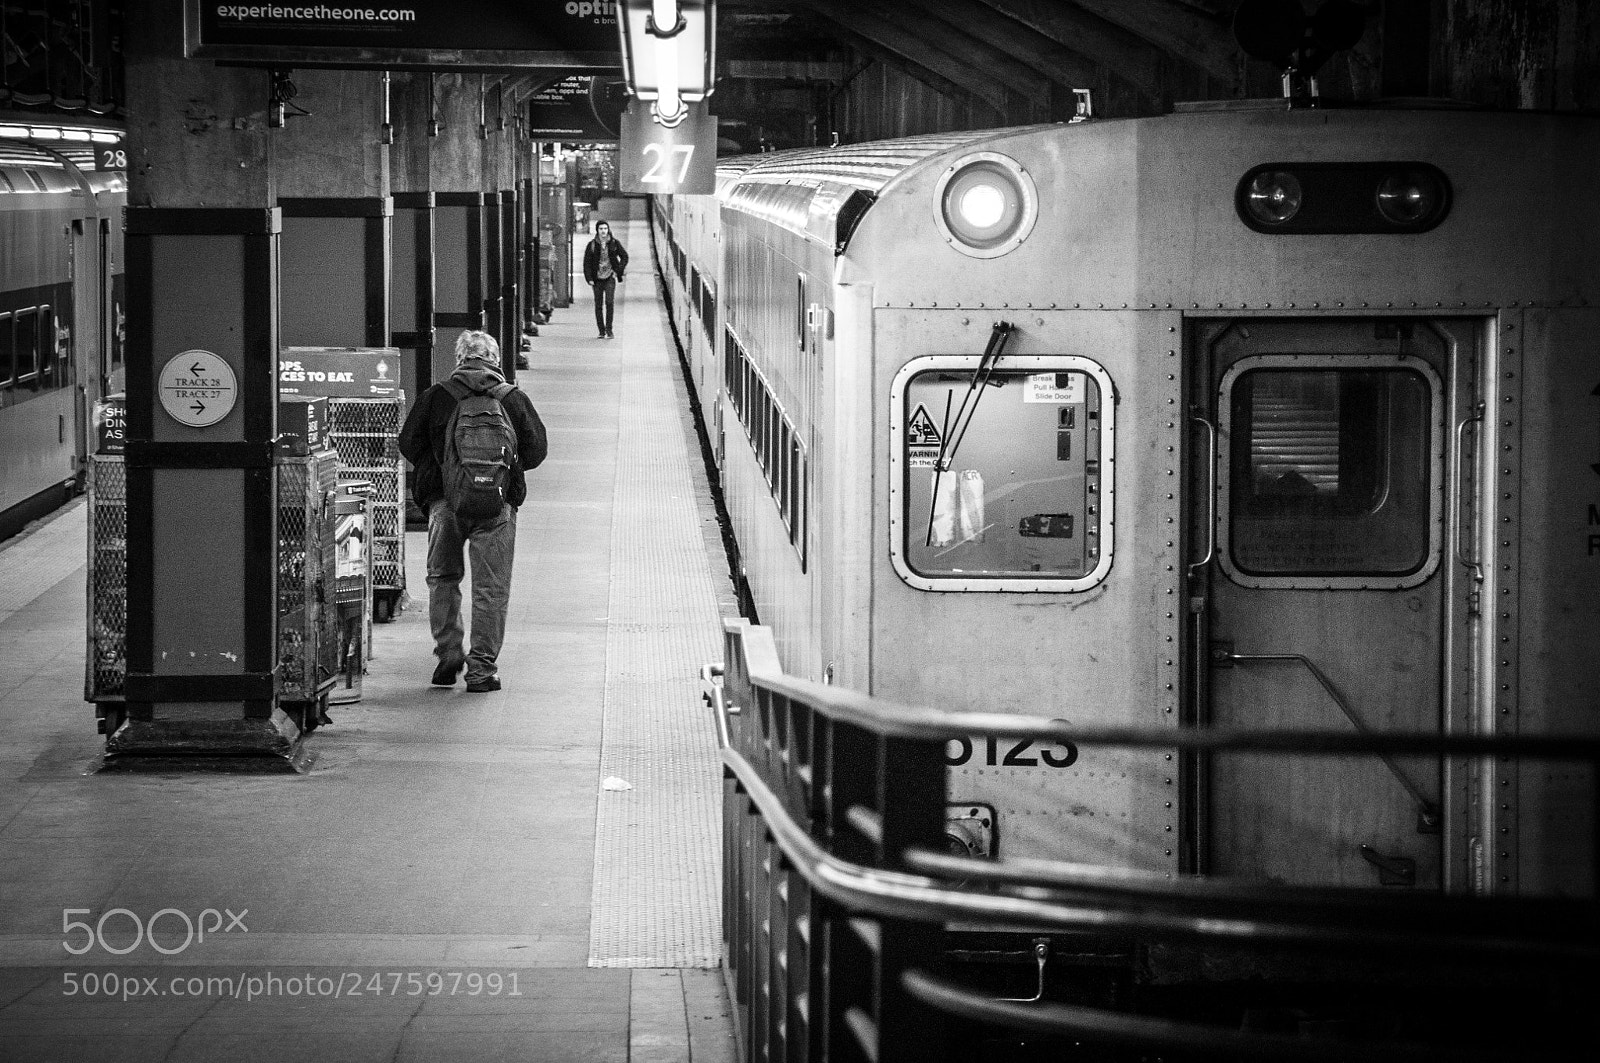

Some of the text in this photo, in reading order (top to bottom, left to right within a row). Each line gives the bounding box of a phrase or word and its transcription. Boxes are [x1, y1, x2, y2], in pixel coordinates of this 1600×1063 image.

[217, 3, 416, 21] experiencetheone.com
[602, 17, 617, 25] bra
[103, 150, 128, 168] 28
[640, 143, 695, 184] 27
[280, 371, 355, 383] CES TO EAT.
[175, 378, 221, 387] TRACK 28
[175, 390, 221, 398] TRACK 27
[105, 407, 127, 417] SH
[105, 429, 123, 439] AS
